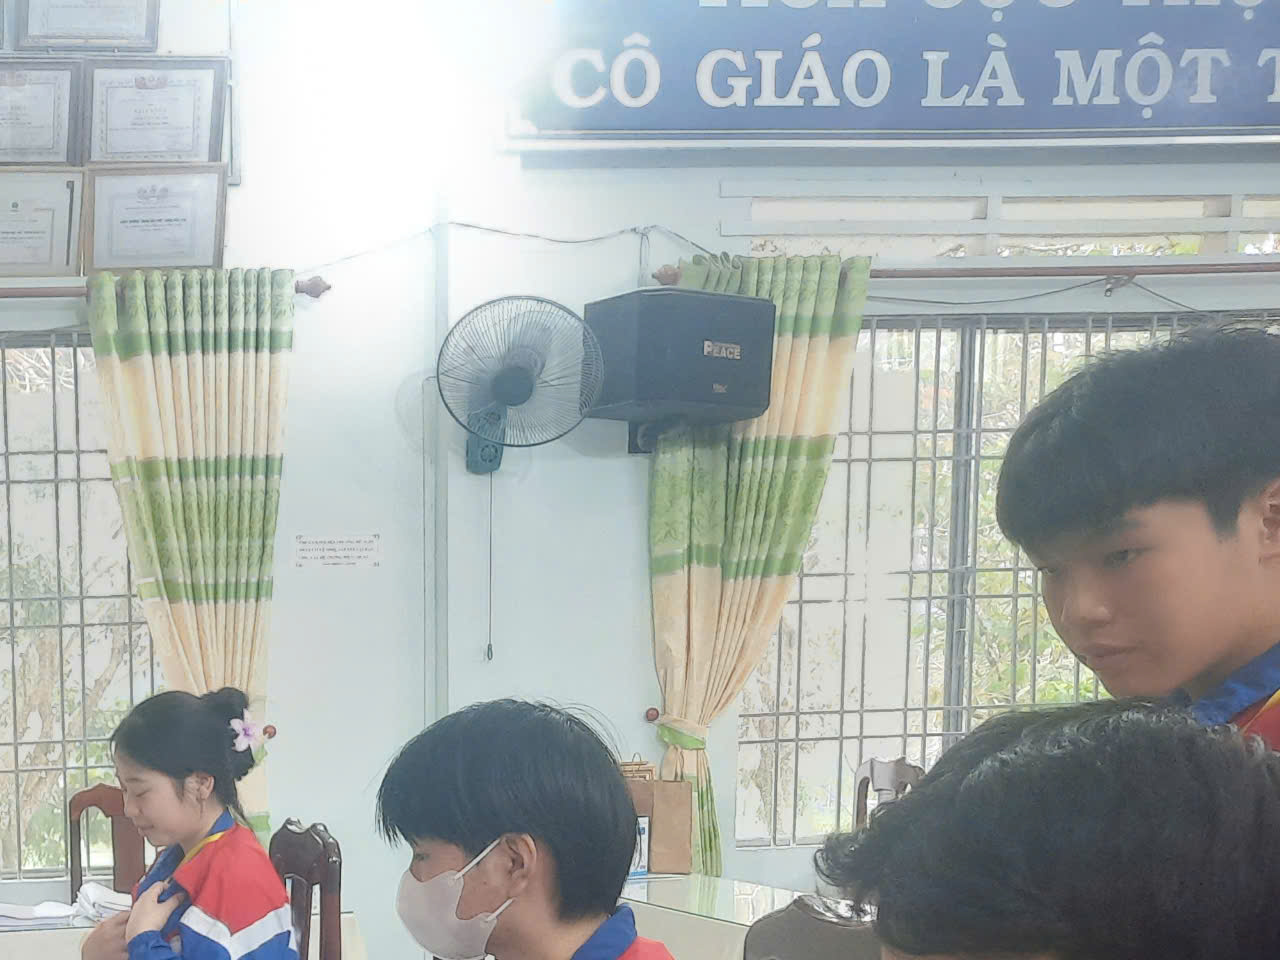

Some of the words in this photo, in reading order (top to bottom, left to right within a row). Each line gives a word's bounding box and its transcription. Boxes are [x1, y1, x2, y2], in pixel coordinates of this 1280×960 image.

[554, 32, 661, 109] CÔ
[695, 32, 892, 108] GIÁO
[920, 33, 1025, 107] LÀ
[1052, 31, 1231, 119] MỘT
